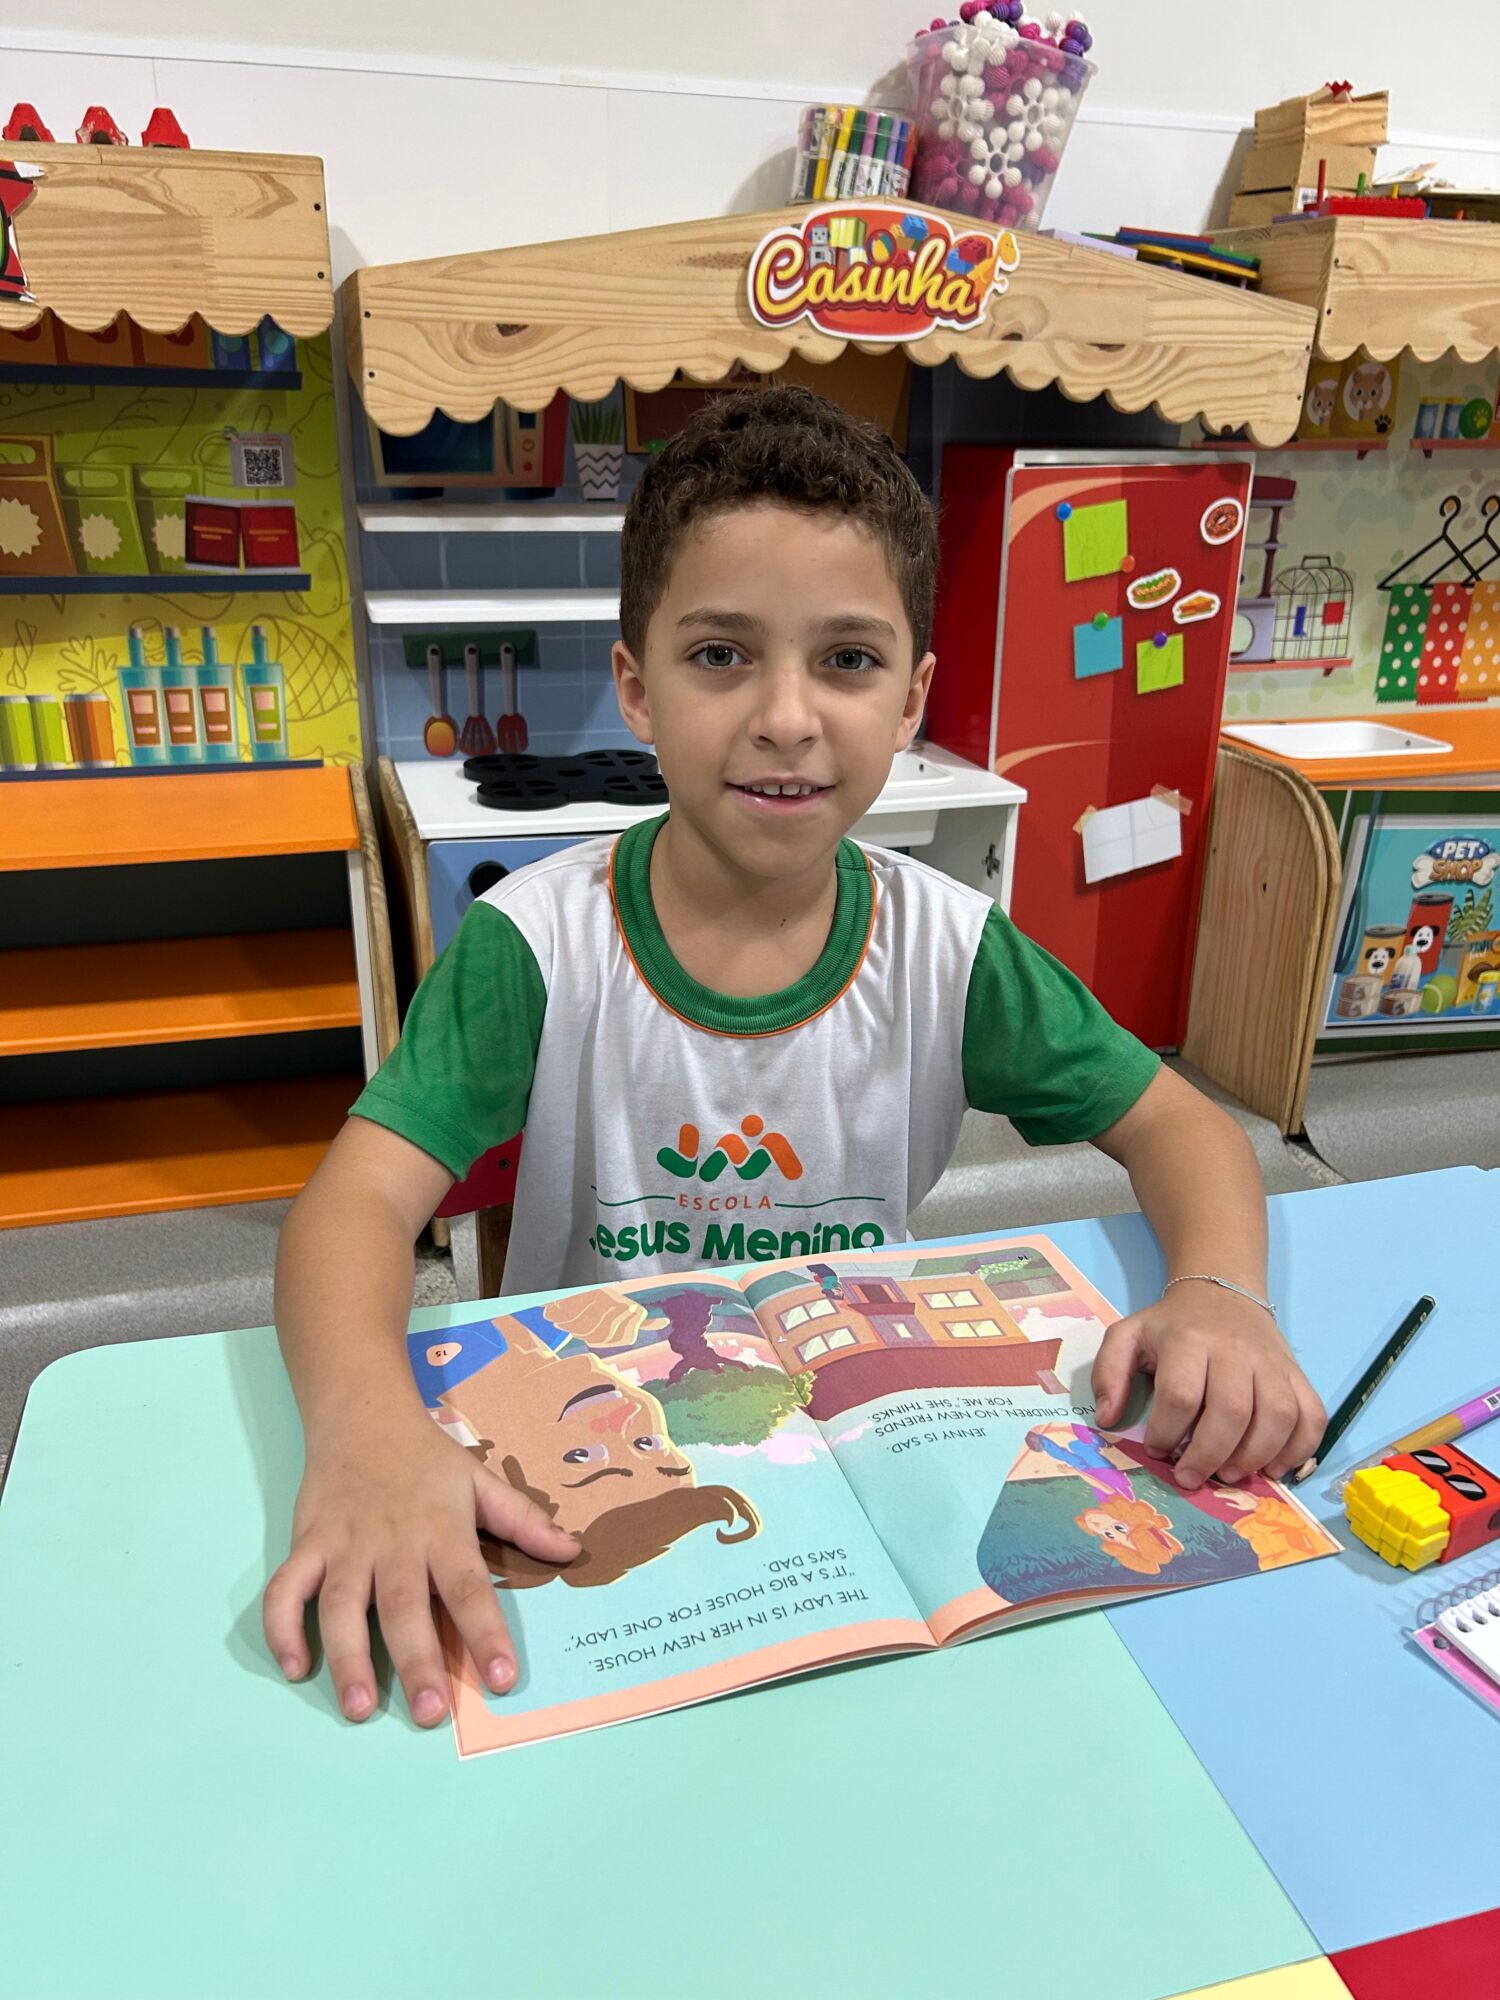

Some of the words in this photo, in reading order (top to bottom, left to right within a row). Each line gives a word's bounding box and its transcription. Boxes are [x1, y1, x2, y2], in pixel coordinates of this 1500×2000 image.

[755, 235, 979, 318] Casinha
[1442, 841, 1480, 859] PET
[679, 1193, 771, 1211] ESCOLA
[701, 1221, 885, 1261] Menino
[929, 1398, 952, 1409] SHE
[987, 1396, 1013, 1406] FOR
[867, 1402, 923, 1423] THINKS.
[937, 1410, 972, 1421] NEW
[975, 1407, 998, 1418] NO
[874, 1415, 933, 1437] FRIENDS
[943, 1427, 986, 1439] JENNY
[886, 1437, 921, 1455] SAD.
[924, 1433, 938, 1443] IS
[807, 1548, 847, 1561] SAYS
[763, 1557, 804, 1573] DAD.
[769, 1574, 798, 1592] BIG
[802, 1572, 813, 1583] A
[705, 1583, 765, 1612] HOUSE
[837, 1588, 869, 1602] THE
[668, 1602, 702, 1624] FOR
[772, 1605, 788, 1621] IS
[793, 1594, 834, 1615] LADY
[623, 1615, 663, 1634] ONE
[748, 1611, 768, 1628] IN
[712, 1621, 744, 1639] HER
[663, 1630, 706, 1654] NEW
[588, 1645, 657, 1672] HOUSE.
